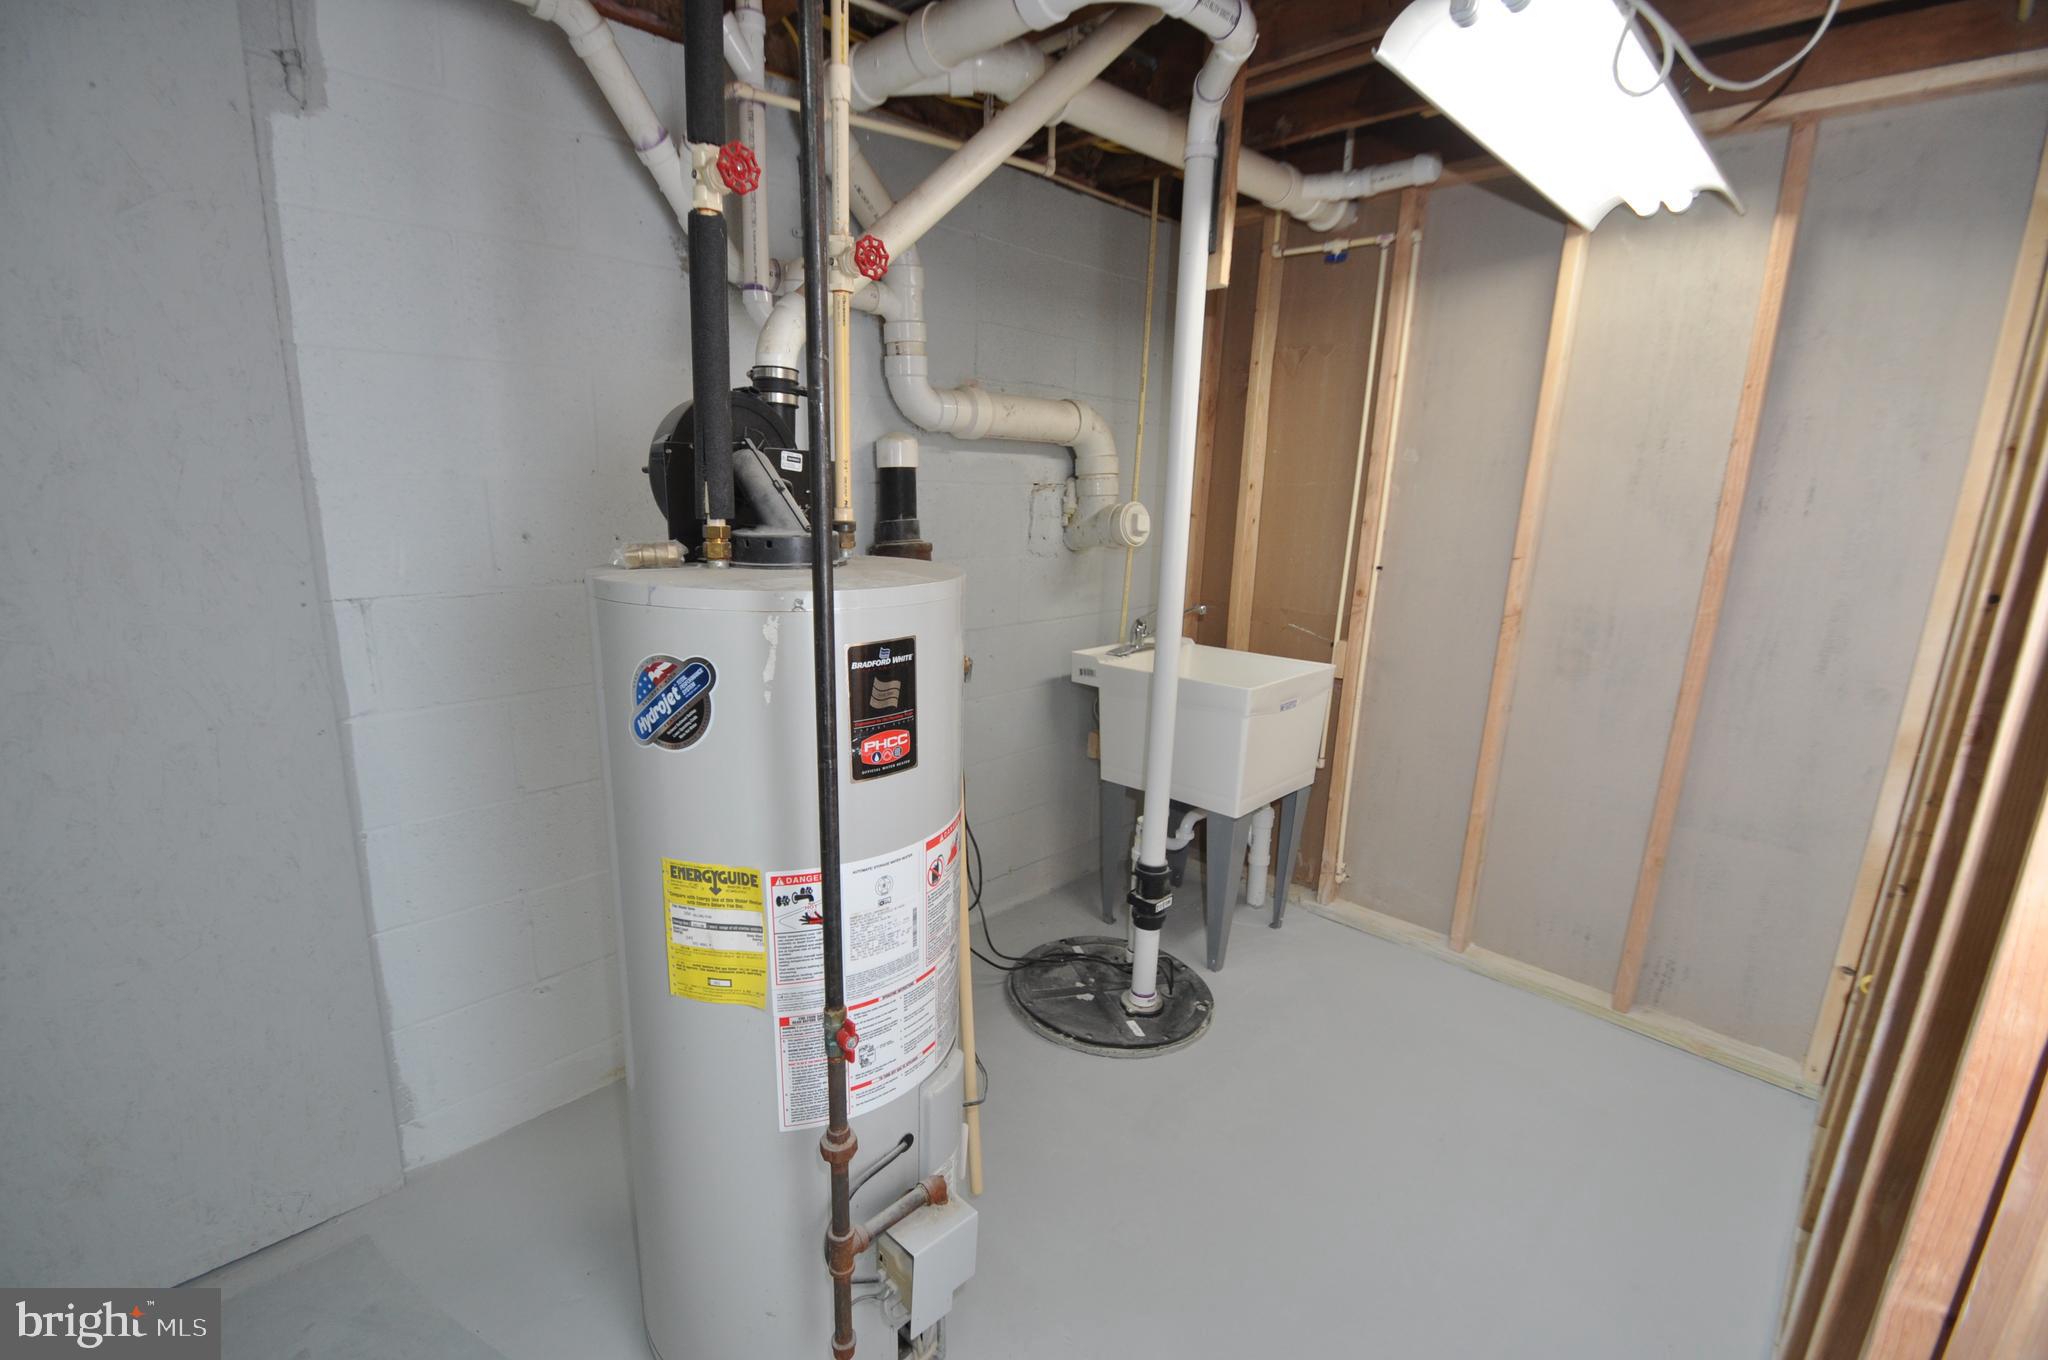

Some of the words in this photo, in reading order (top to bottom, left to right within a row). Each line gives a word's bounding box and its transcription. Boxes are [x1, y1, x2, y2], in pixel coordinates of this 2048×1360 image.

[851, 658, 891, 670] BRADFORD
[892, 653, 913, 664] WHITE
[637, 684, 681, 735] Hydrojet
[864, 733, 909, 753] PHCC
[670, 865, 759, 888] ENERGYGUIDE
